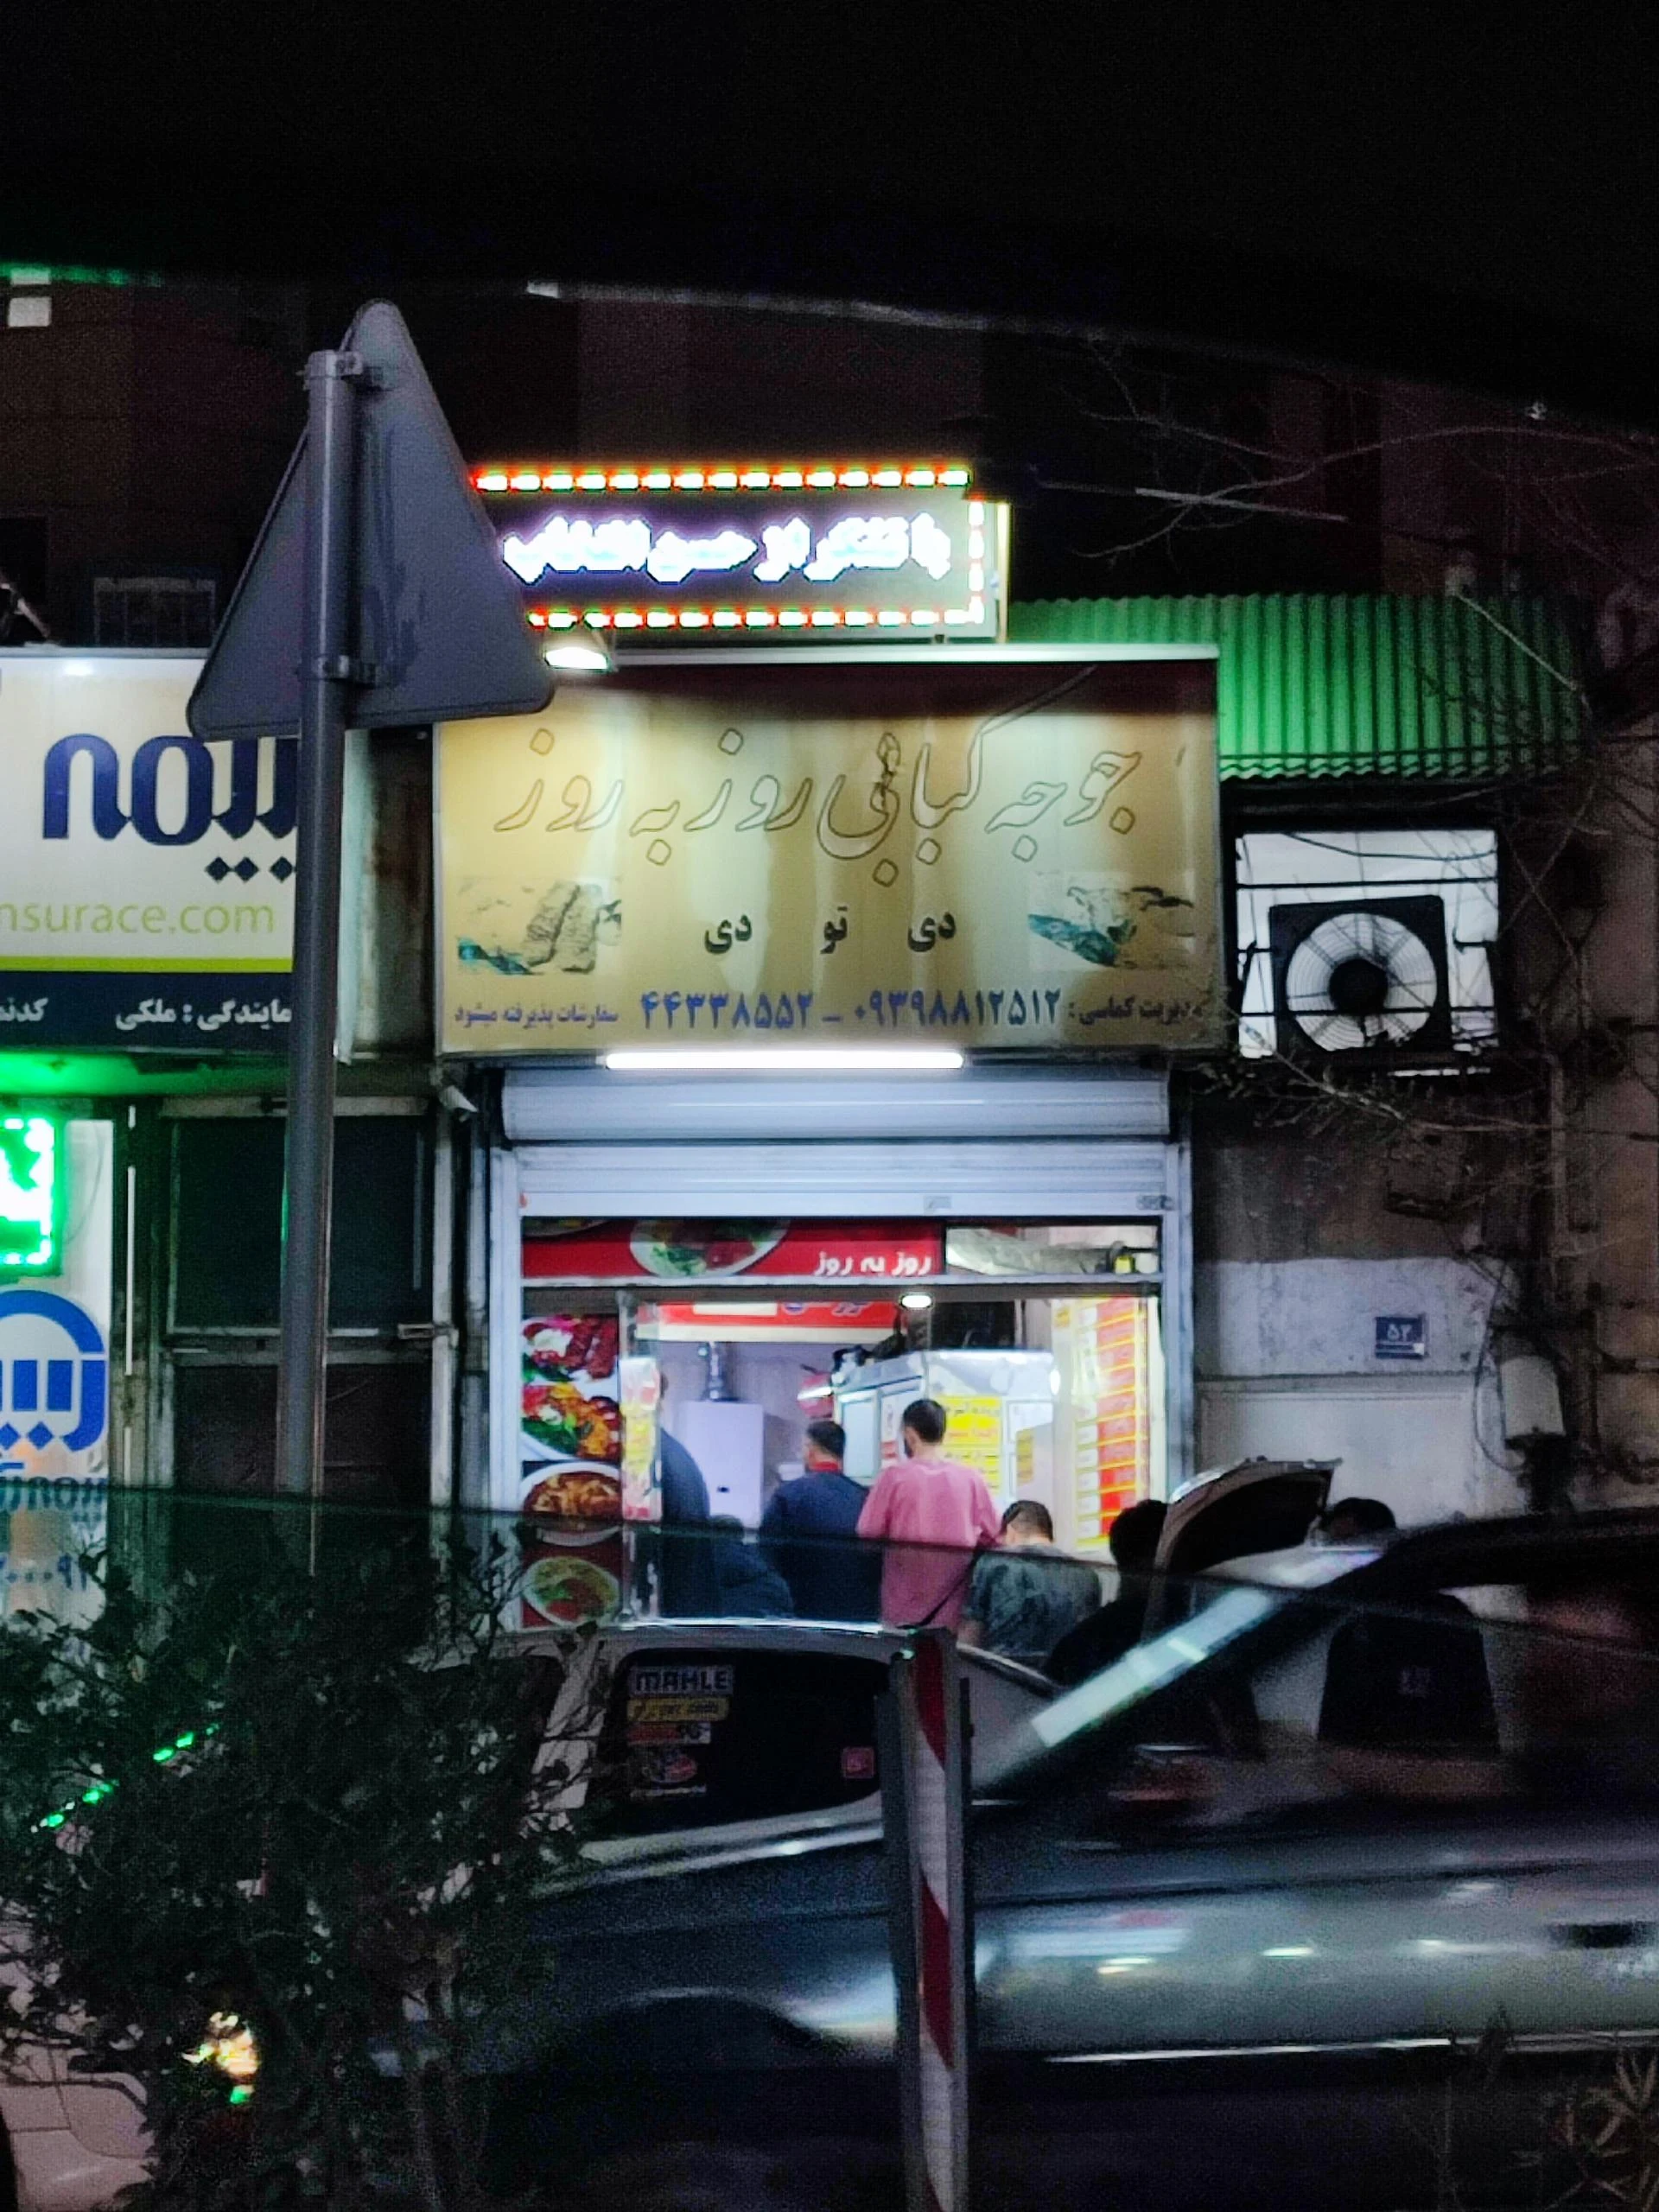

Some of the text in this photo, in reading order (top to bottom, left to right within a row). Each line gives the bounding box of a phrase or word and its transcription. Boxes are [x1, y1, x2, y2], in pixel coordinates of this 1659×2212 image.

[493, 664, 1142, 887] جوجه کبابی روز به روز
[704, 906, 957, 954] دی تو دی
[116, 998, 177, 1031] ملکی
[557, 1003, 619, 1030] سفارشات
[640, 991, 812, 1030] ۴۴۳۳۸۵۵۲
[855, 989, 1061, 1027] ۰۹۳۹۸۸۱۲۵۱۲
[813, 1251, 931, 1277] روز به روز
[635, 1670, 728, 1691] MAHLE
